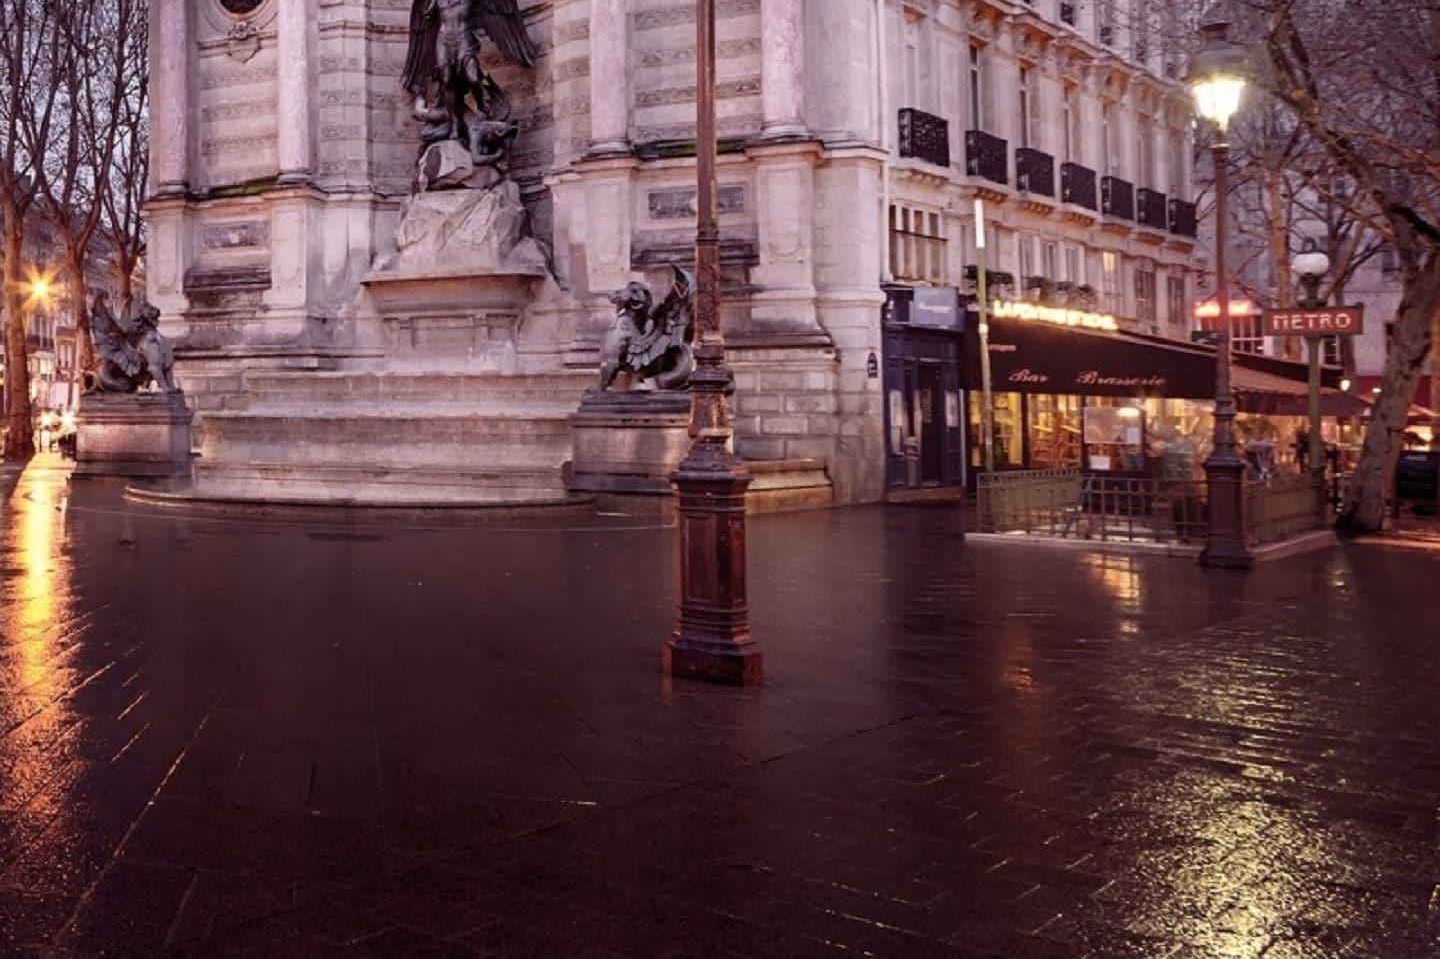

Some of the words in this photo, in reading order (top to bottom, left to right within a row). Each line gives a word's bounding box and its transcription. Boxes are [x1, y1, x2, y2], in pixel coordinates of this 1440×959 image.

[1272, 313, 1351, 331] METRO
[1009, 368, 1049, 383] Bar
[1075, 371, 1167, 387] Brasserie
